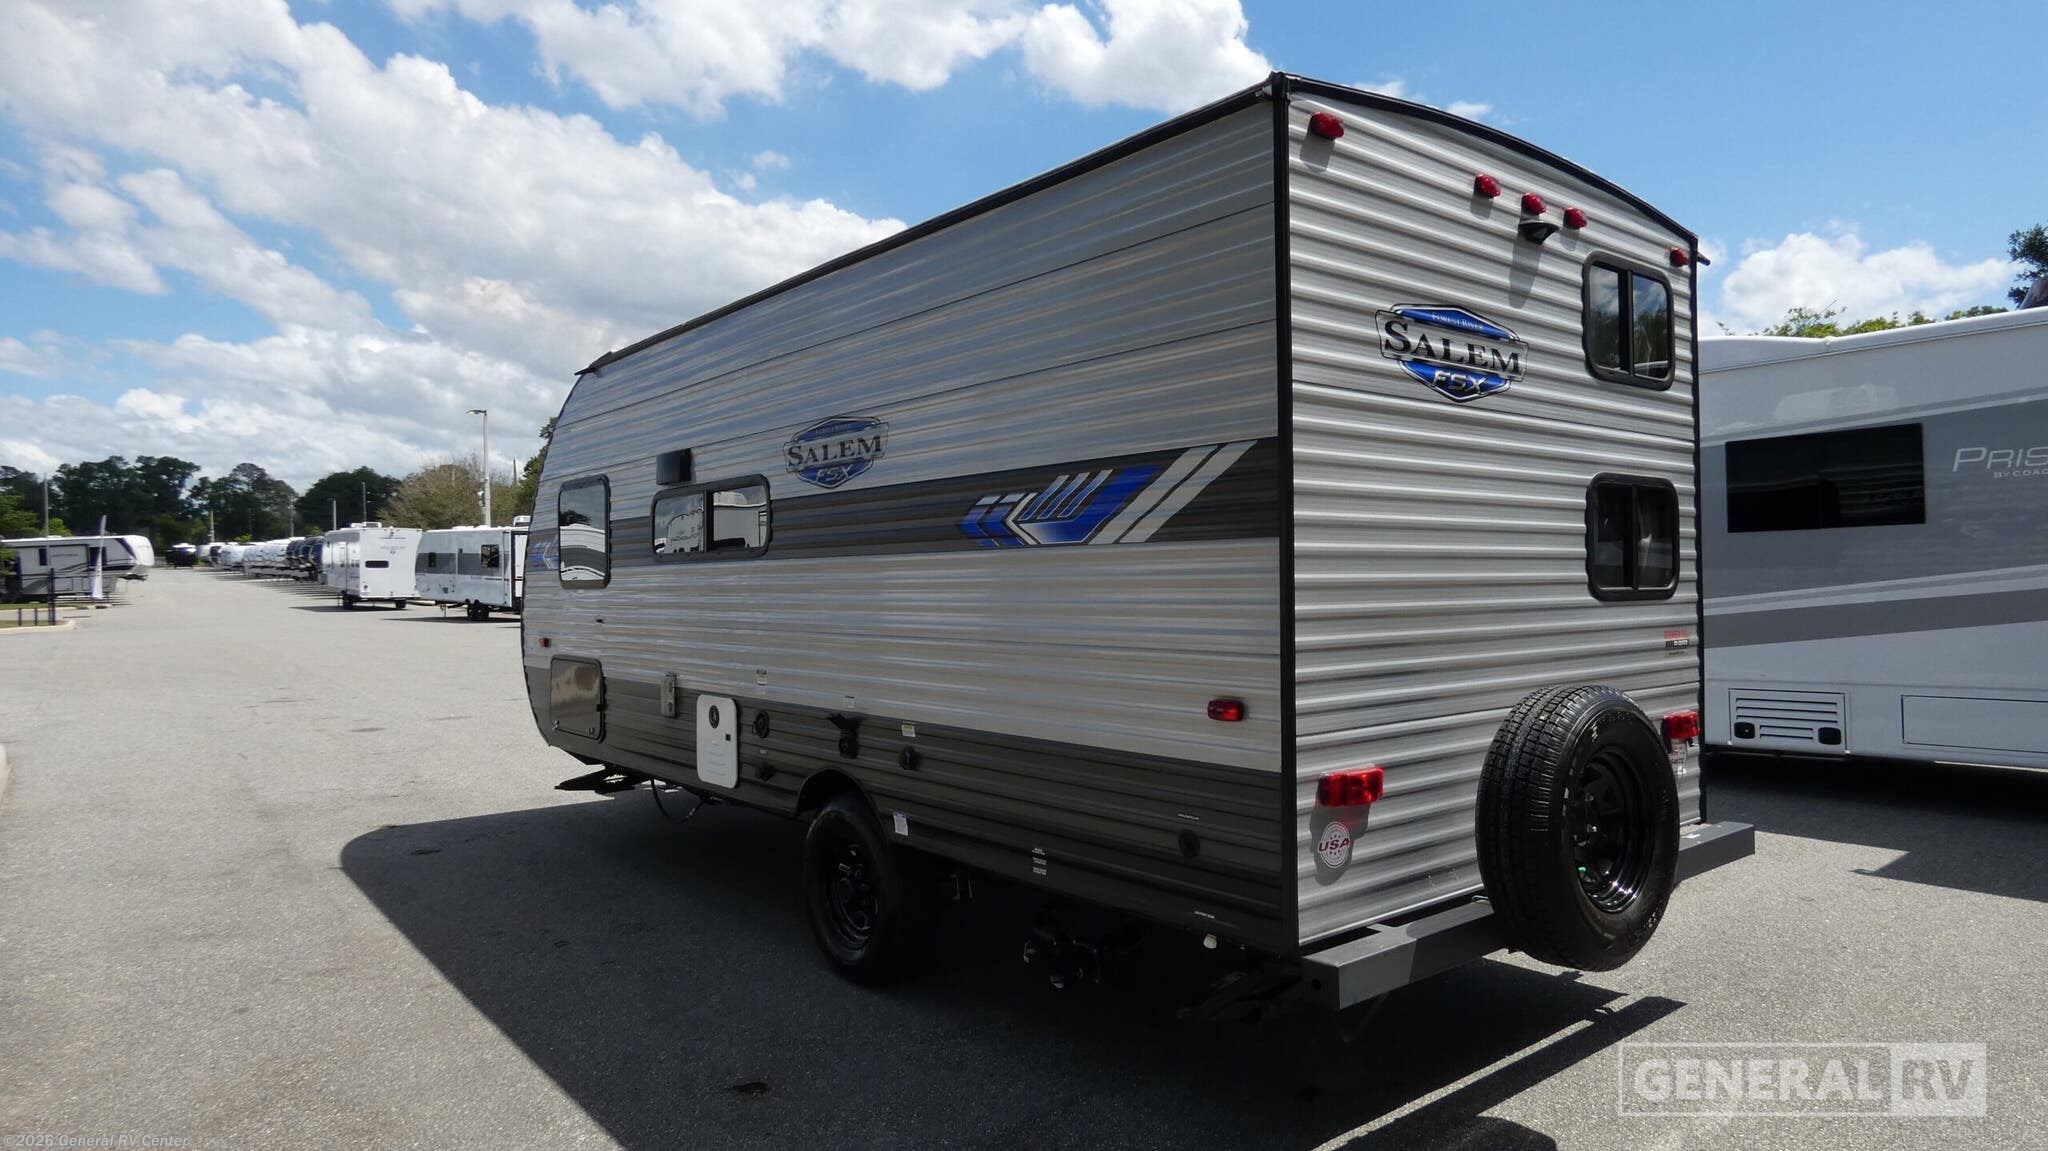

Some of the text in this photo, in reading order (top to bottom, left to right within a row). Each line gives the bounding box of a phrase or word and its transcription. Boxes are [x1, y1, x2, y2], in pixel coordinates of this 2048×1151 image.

[1384, 320, 1520, 374] SALEM
[1431, 369, 1488, 395] FSX
[788, 436, 881, 467] SALEM
[815, 463, 854, 482] FSX
[1993, 471, 2010, 479] BY
[1318, 838, 1350, 852] USA
